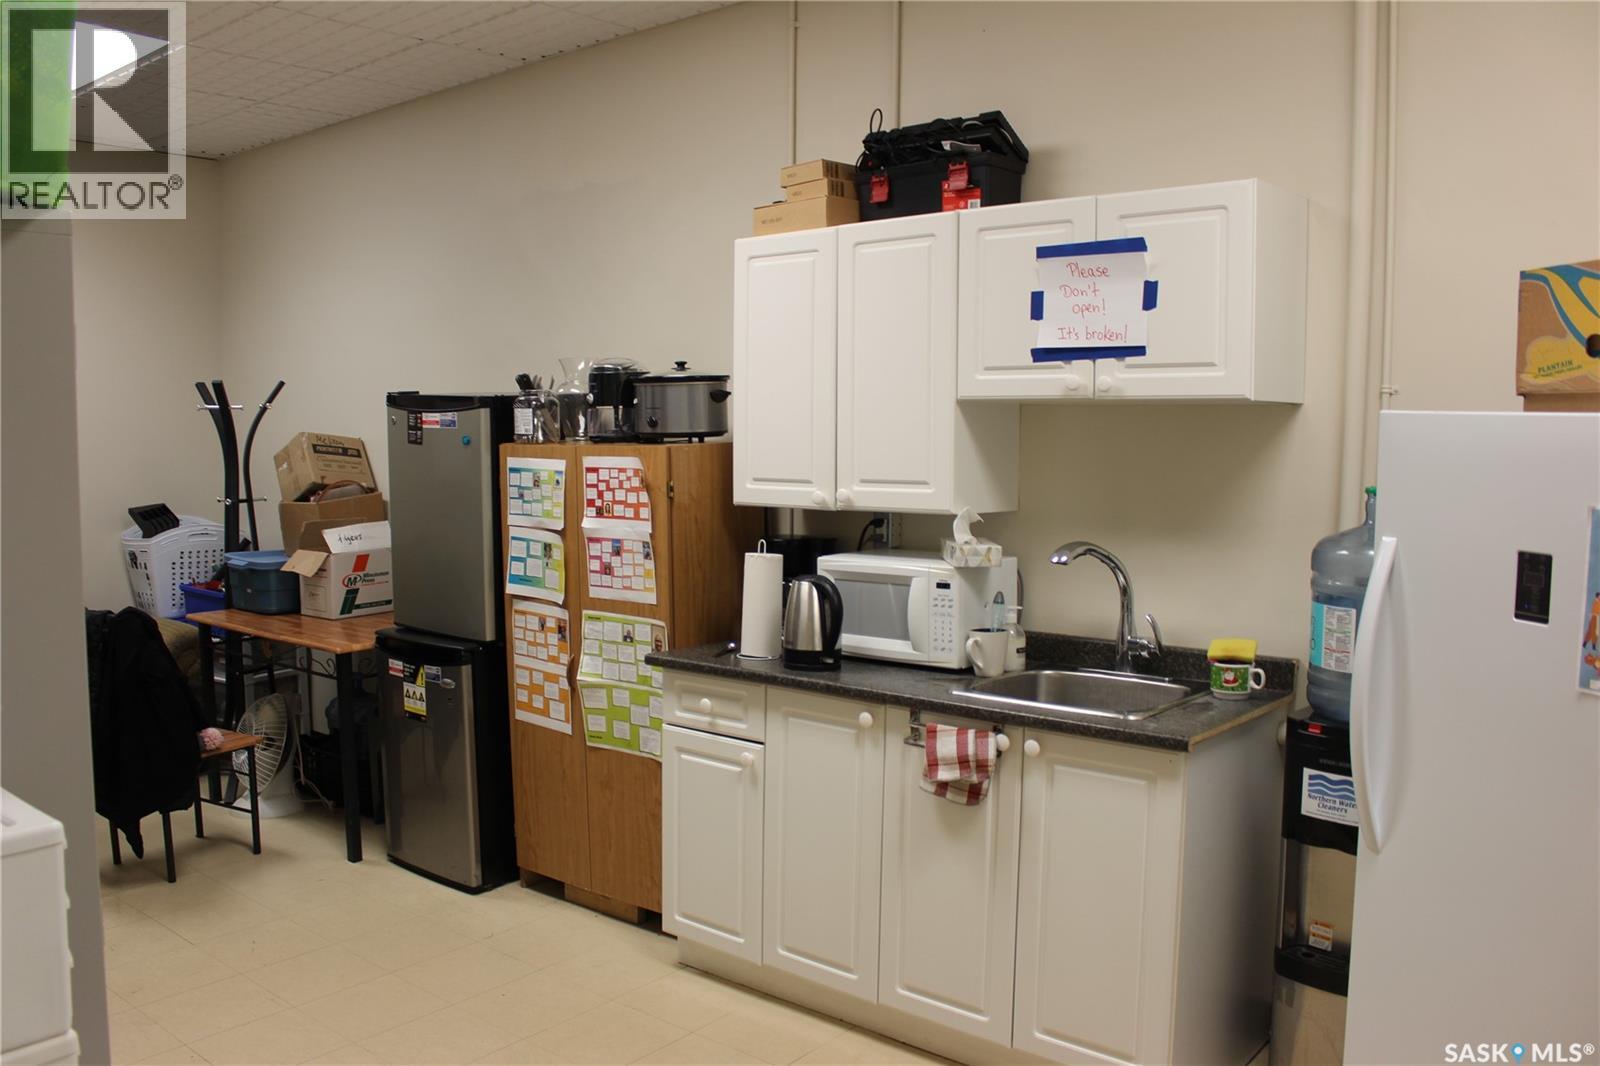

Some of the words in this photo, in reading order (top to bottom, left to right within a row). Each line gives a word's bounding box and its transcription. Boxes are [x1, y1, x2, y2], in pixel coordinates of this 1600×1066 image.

[1066, 261, 1110, 278] Please
[1059, 282, 1100, 298] Don't
[1072, 299, 1106, 319] open!
[1058, 327, 1079, 341] It's
[1085, 323, 1128, 343] broken!
[1538, 359, 1573, 374] PLANTAIN
[1308, 793, 1337, 805] Northern
[1338, 800, 1358, 809] Wate
[1317, 803, 1348, 813] Cleaners
